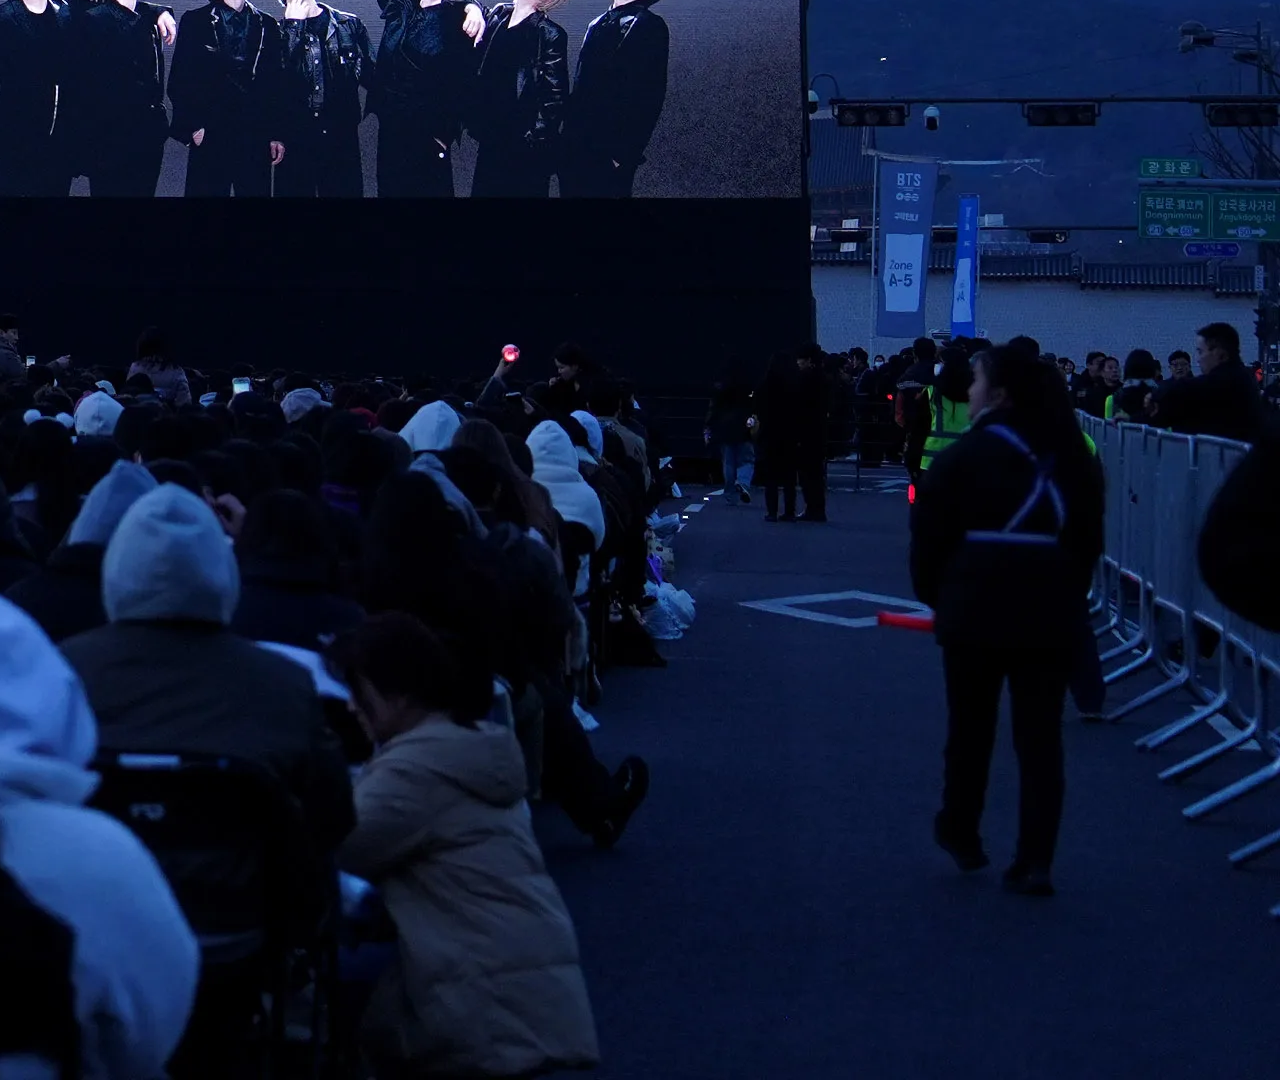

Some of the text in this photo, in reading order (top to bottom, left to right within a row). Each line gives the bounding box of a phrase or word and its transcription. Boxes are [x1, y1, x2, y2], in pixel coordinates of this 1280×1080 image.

[897, 173, 921, 187] BTS
[889, 261, 913, 270] Zone
[889, 273, 913, 287] A-5
